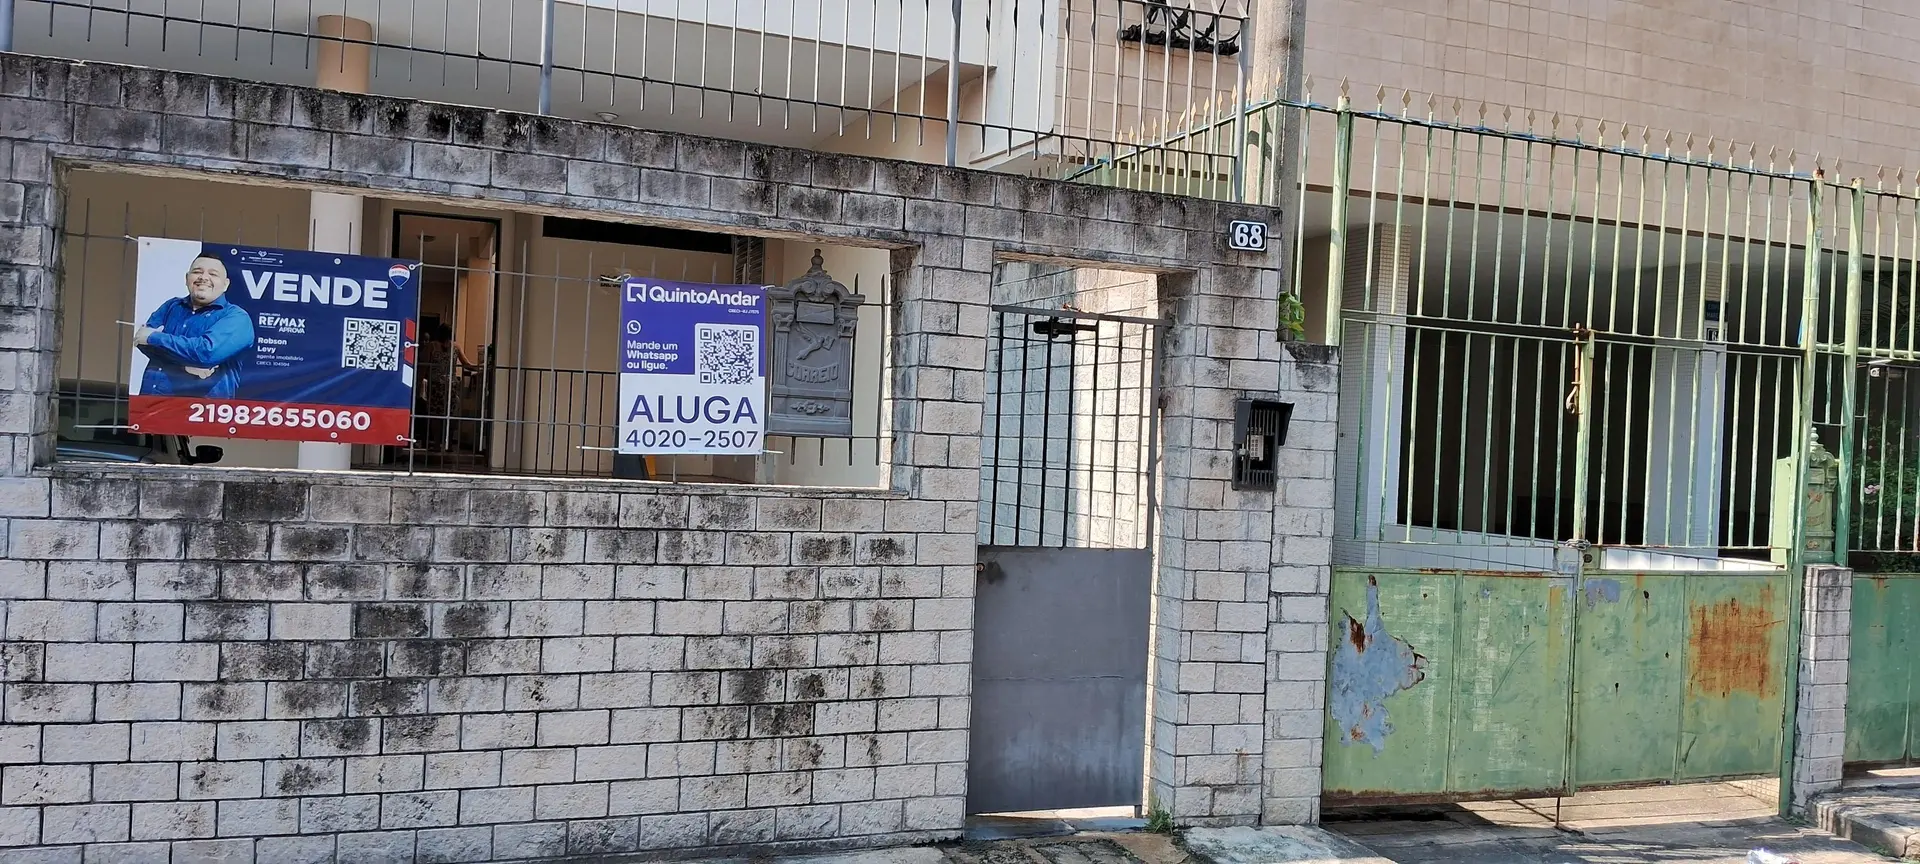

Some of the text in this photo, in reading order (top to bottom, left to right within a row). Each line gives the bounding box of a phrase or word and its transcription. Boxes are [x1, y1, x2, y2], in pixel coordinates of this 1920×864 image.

[1235, 224, 1262, 247] 68
[241, 269, 389, 309] VENDE
[649, 286, 760, 306] QuintoAndar
[258, 316, 306, 328] RE/MAX
[278, 326, 306, 334] APROVA
[258, 337, 288, 345] Robson
[627, 340, 661, 350] Mande
[257, 345, 276, 354] Levy
[626, 349, 678, 361] Whatsapp
[641, 360, 669, 371] ligue.
[627, 394, 758, 424] ALUGA
[188, 403, 371, 431] 21982655060
